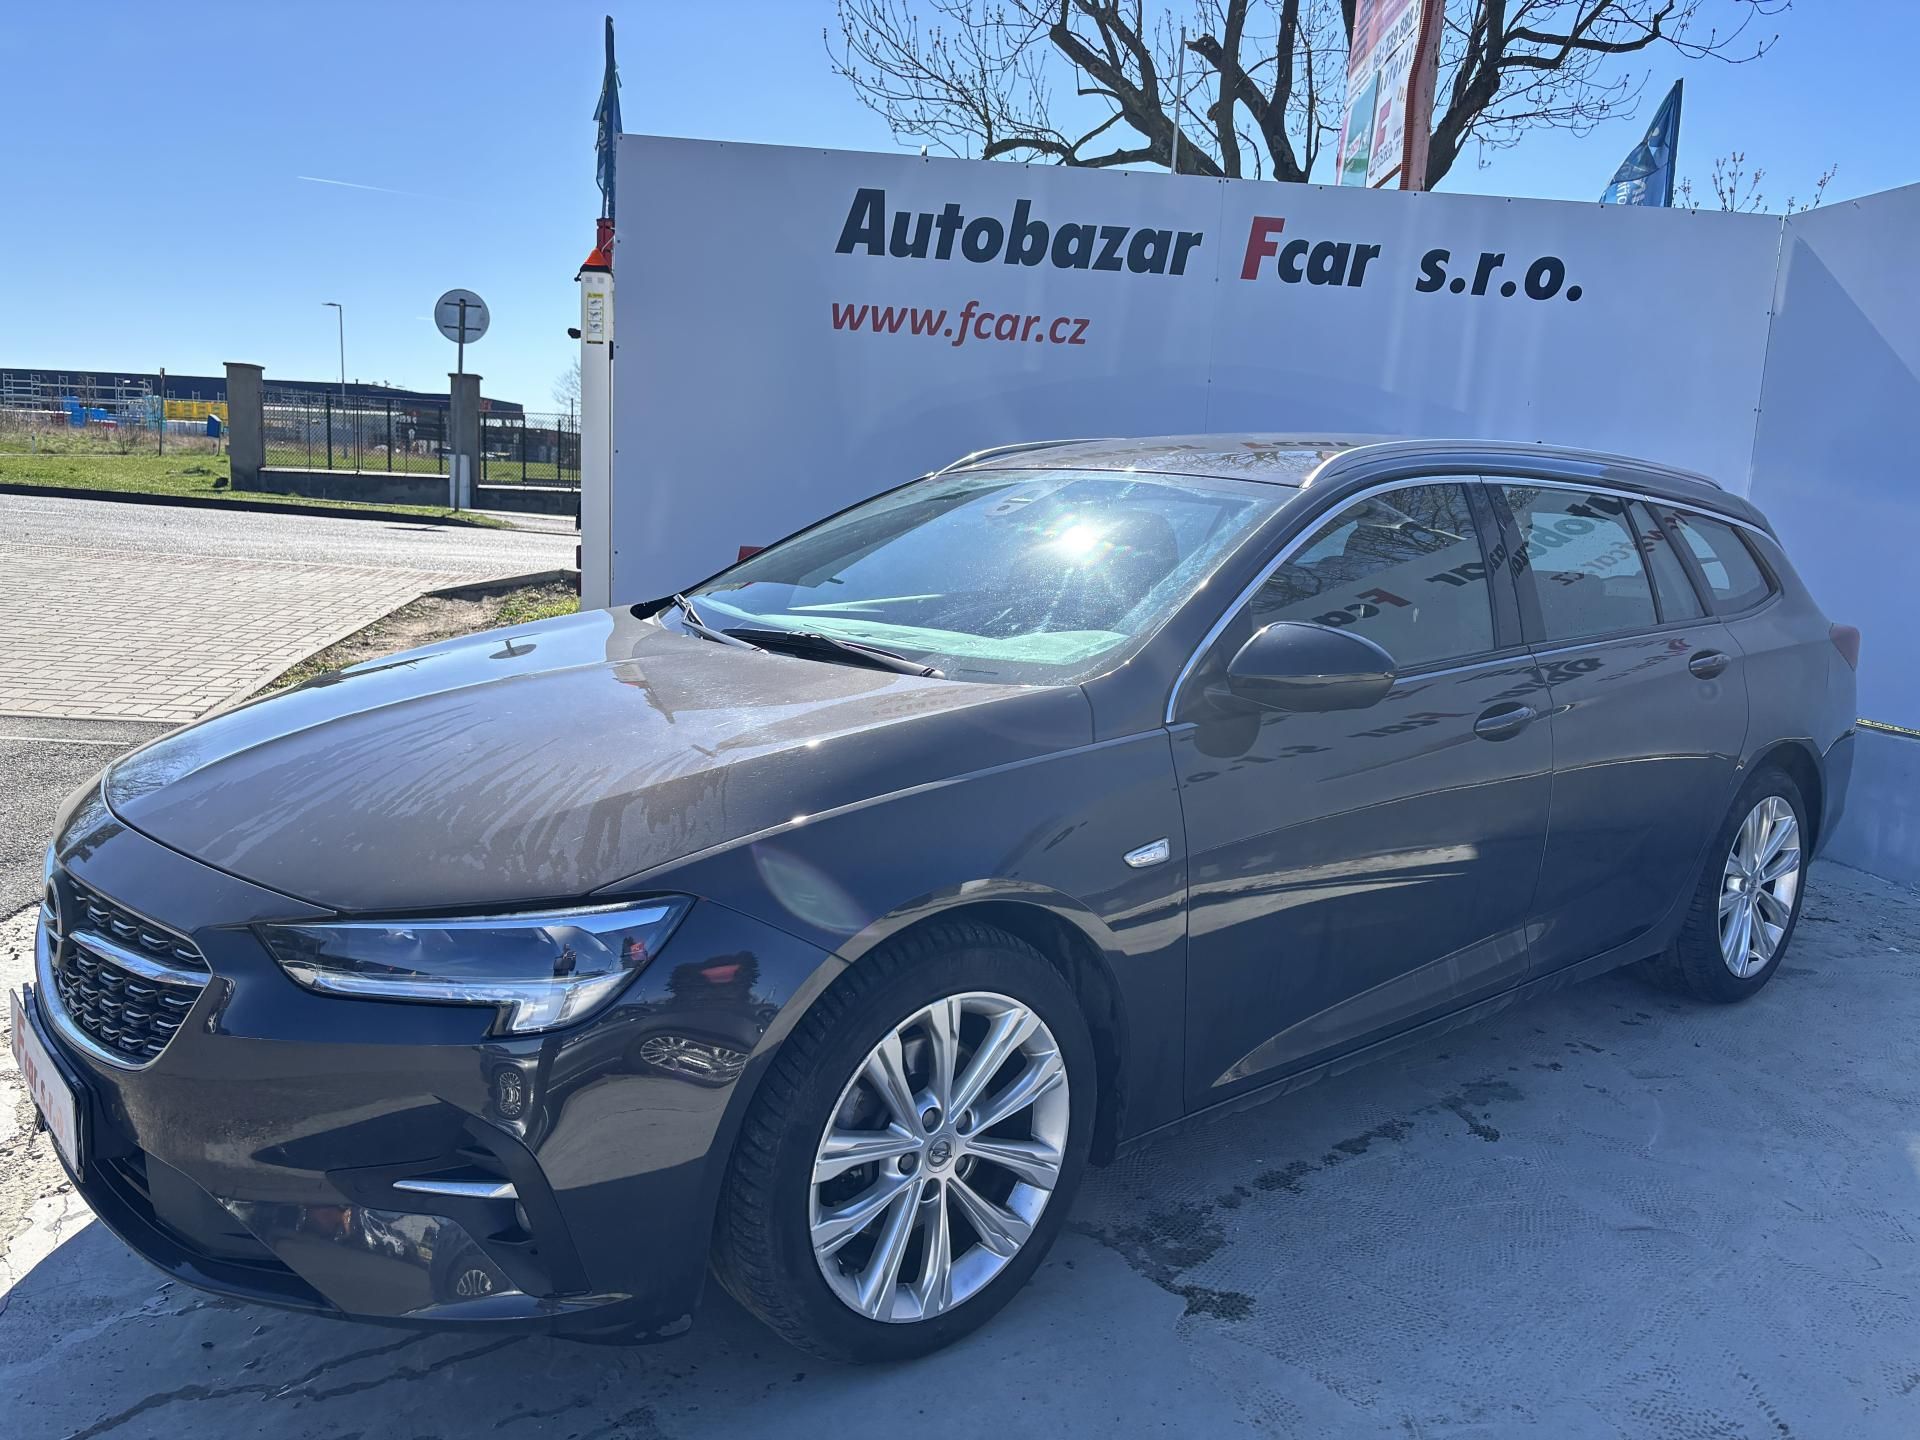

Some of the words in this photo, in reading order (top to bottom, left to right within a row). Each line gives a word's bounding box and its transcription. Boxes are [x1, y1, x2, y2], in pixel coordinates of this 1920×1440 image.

[835, 187, 1203, 276] Autobazar
[1240, 216, 1382, 288] Fcar
[1415, 249, 1583, 302] s.r.o.
[831, 300, 1091, 347] www.fcar.cz
